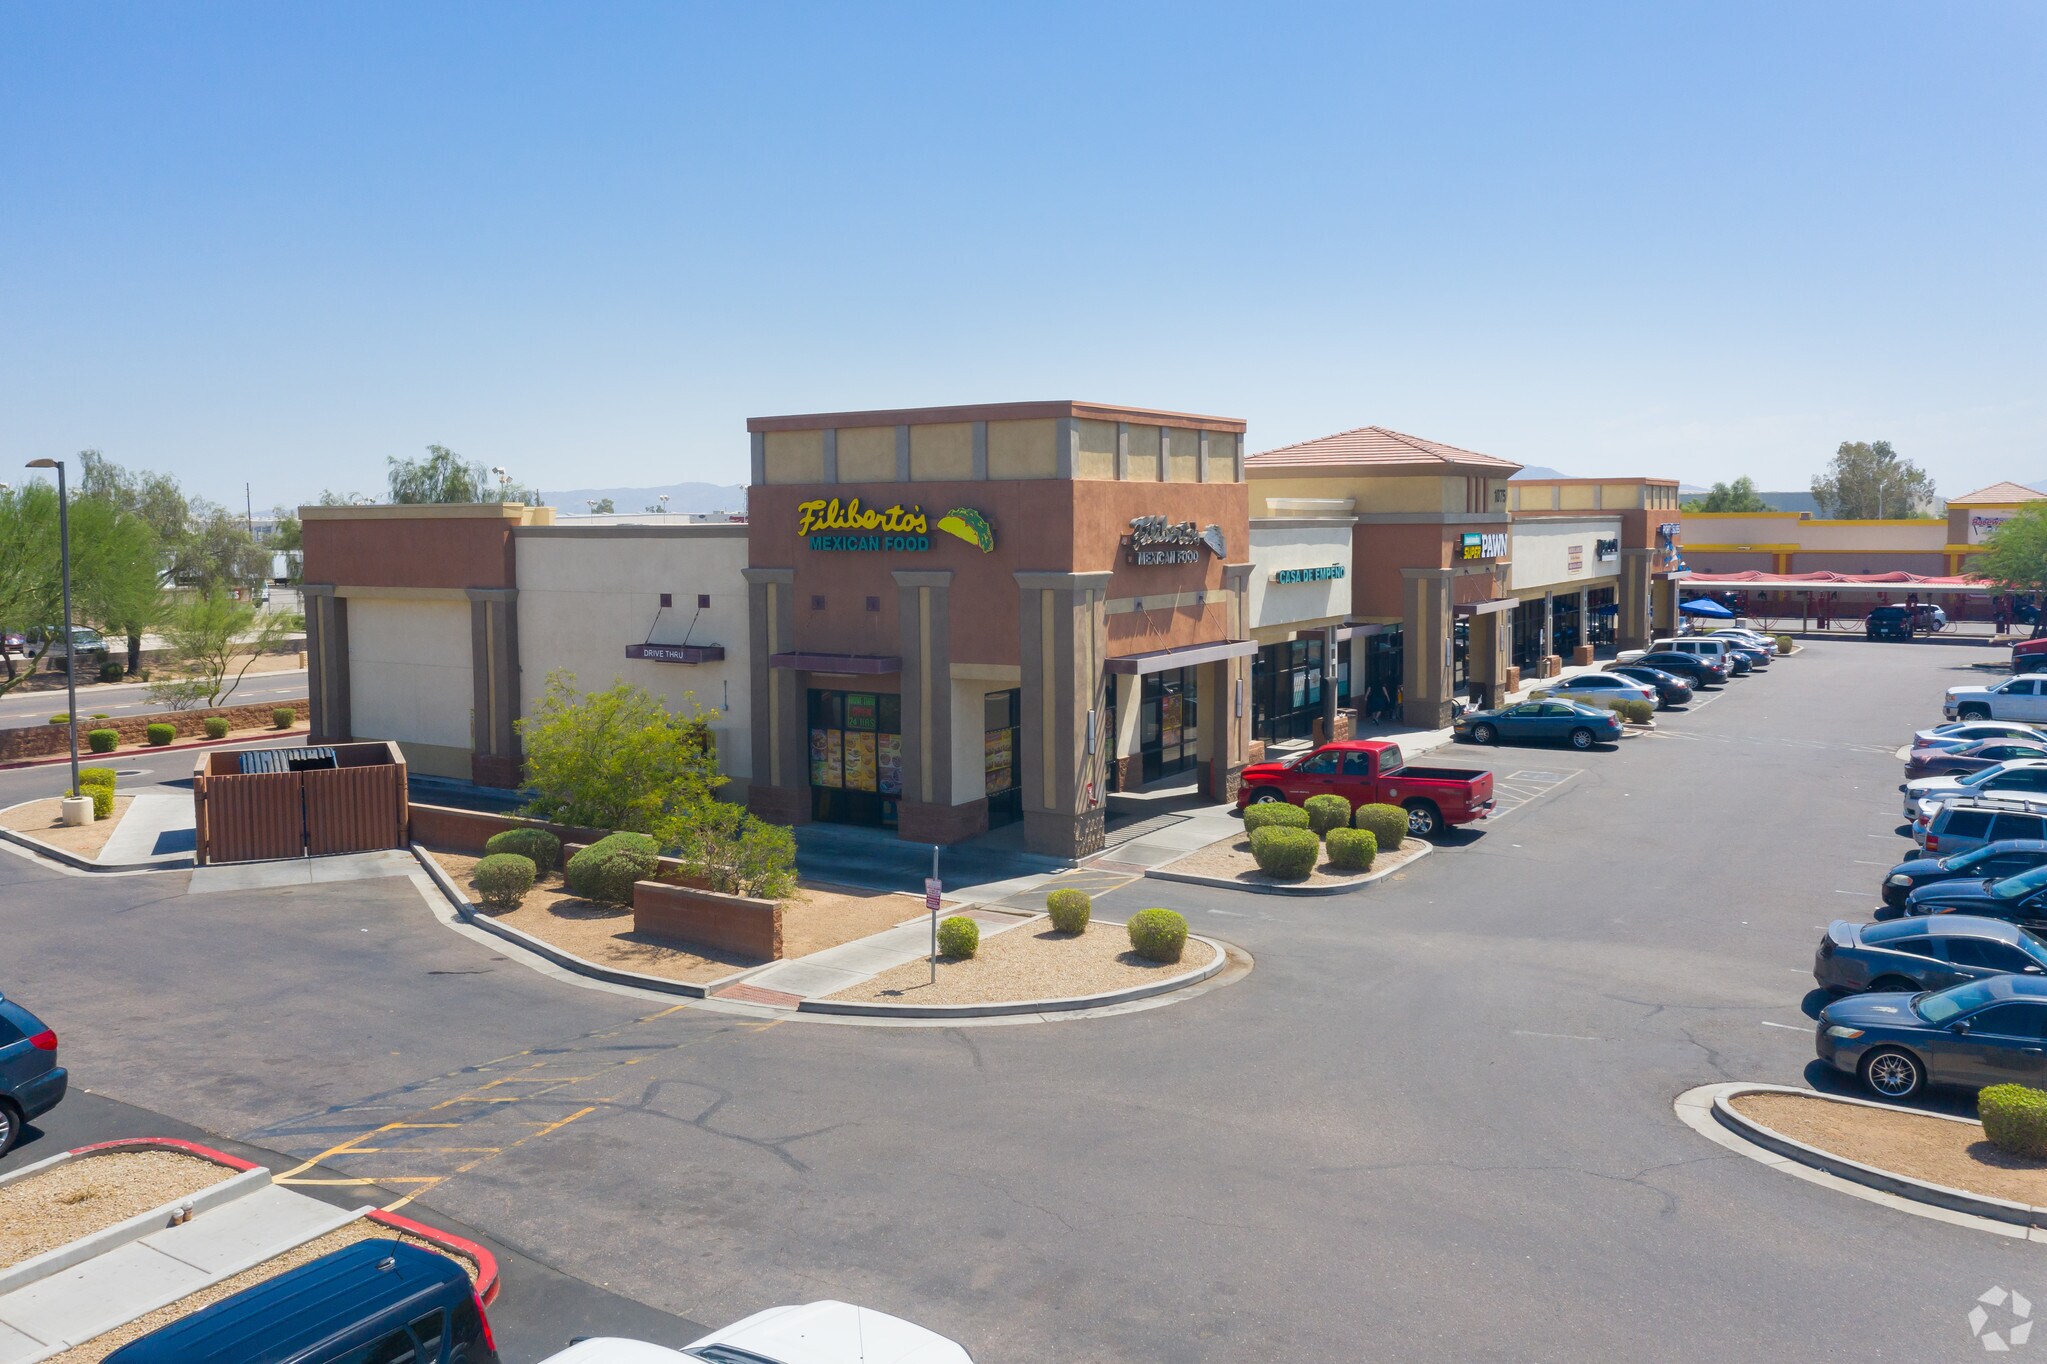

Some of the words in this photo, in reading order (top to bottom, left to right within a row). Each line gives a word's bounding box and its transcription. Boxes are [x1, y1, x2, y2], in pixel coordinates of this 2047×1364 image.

[798, 498, 927, 536] Filiberto's
[809, 536, 879, 551] MEXICAN
[885, 537, 929, 551] FOOD
[1464, 546, 1481, 559] SUPER
[1481, 534, 1507, 557] PAWN
[1137, 551, 1175, 565] MEXICAN
[1177, 550, 1198, 564] FOOD
[1280, 570, 1300, 584] CASA
[1303, 569, 1314, 582] DE
[1315, 563, 1345, 581] EMPEÑO
[643, 649, 664, 658] DRIVE
[666, 650, 684, 659] THRU
